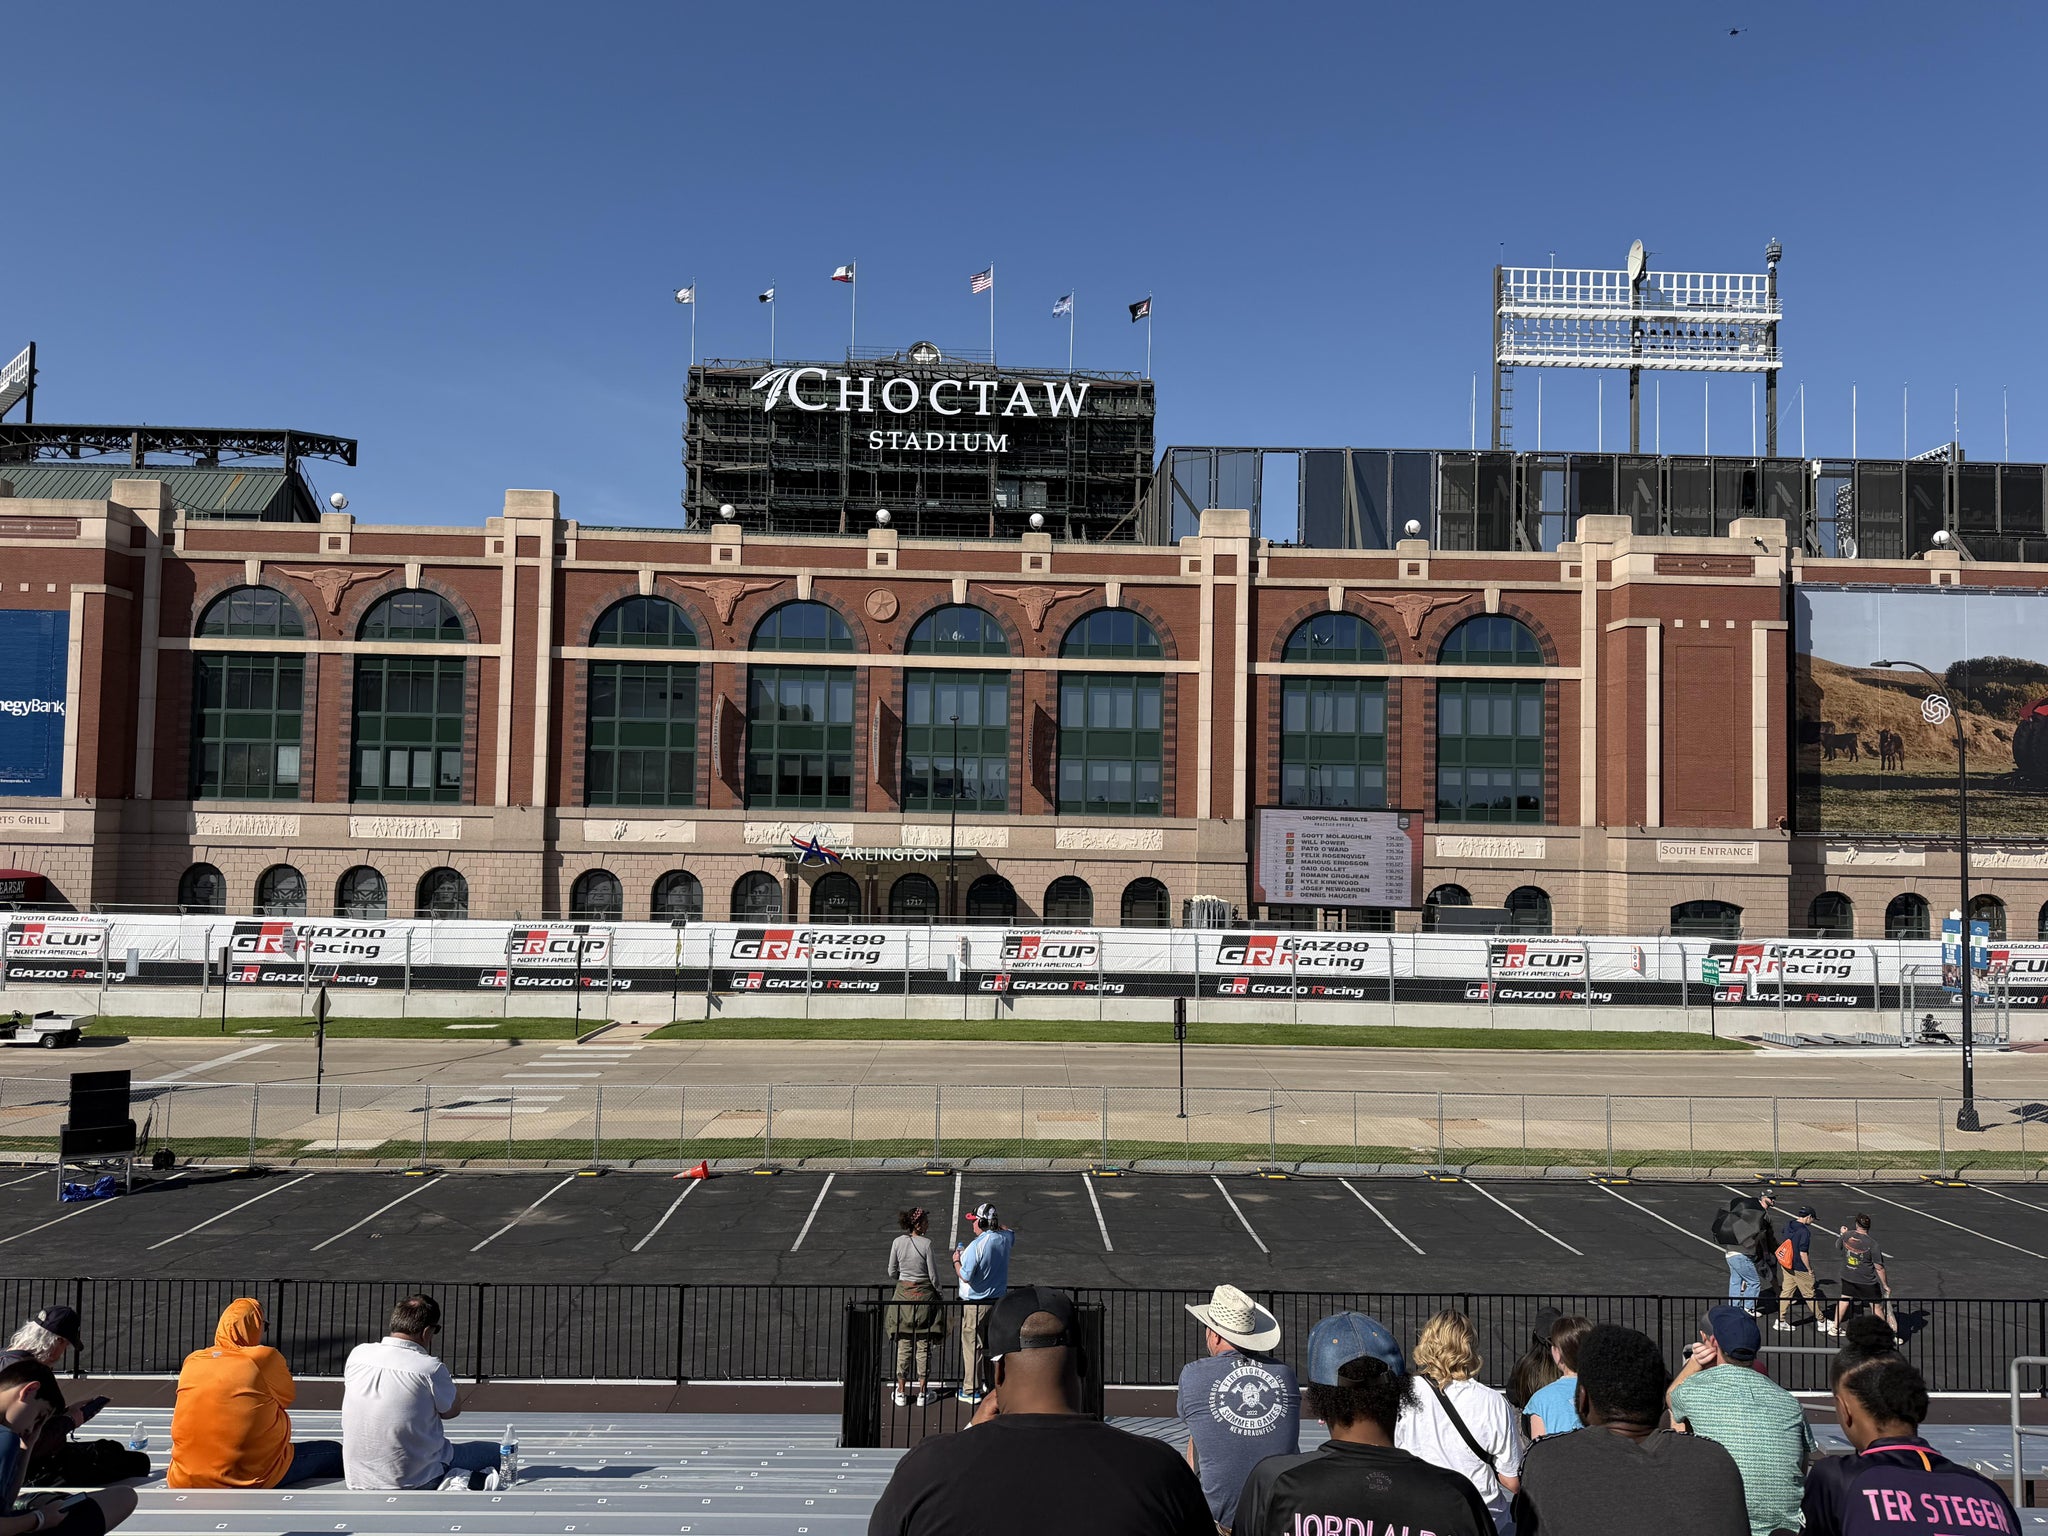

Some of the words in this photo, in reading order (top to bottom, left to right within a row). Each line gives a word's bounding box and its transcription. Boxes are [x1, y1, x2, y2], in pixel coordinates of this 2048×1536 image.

[788, 368, 1090, 418] CHOCTAW
[869, 431, 1009, 453] STADIUM
[0, 815, 14, 824] TS
[18, 815, 51, 825] GRILL
[841, 846, 939, 862] ARLINGTON
[1661, 845, 1696, 856] SOUTH
[1699, 846, 1754, 856] ENTRANCE
[80, 916, 109, 924] Racing
[6, 931, 43, 945] GR
[46, 932, 101, 946] CUP
[231, 934, 284, 953] GR
[732, 940, 789, 959] GR
[798, 931, 886, 945] GAZOO
[549, 940, 605, 953] CUP
[1004, 944, 1038, 958] GR
[1041, 945, 1096, 958] CUP
[1218, 946, 1275, 965] GR
[1282, 938, 1370, 952] GAZOO
[1769, 946, 1856, 959] GAZOO
[794, 946, 881, 964] Racing
[1279, 953, 1365, 972] Racing
[1528, 953, 1584, 967] CUP
[1766, 961, 1852, 978] Racing
[2011, 959, 2048, 972] CU
[9, 968, 68, 978] GAZOO
[71, 969, 126, 982] Racng
[228, 971, 257, 982] GR
[333, 973, 379, 986] acing
[480, 976, 507, 986] GR
[514, 976, 573, 987] GAZOO
[732, 977, 762, 988] GR
[765, 978, 824, 989] GAZOO
[826, 979, 880, 992] Racing
[980, 980, 1008, 990] GR
[1012, 980, 1069, 991] GAZOO
[1219, 983, 1247, 994] GR
[1251, 983, 1308, 995] GAZOO
[1311, 985, 1365, 999] Racing
[1499, 988, 1556, 1000] GAZOO
[1714, 991, 1742, 1001] GR
[1805, 993, 1857, 1006] Racing
[1222, 1367, 1277, 1388] FIREFIGHTER
[1221, 1408, 1256, 1429] SUMMER
[1256, 1405, 1281, 1427] GAMES
[1229, 1424, 1243, 1436] NEW
[1243, 1422, 1277, 1437] BRAUNFELS
[1862, 1489, 1917, 1522] TER
[1920, 1493, 2011, 1535] STEGEN
